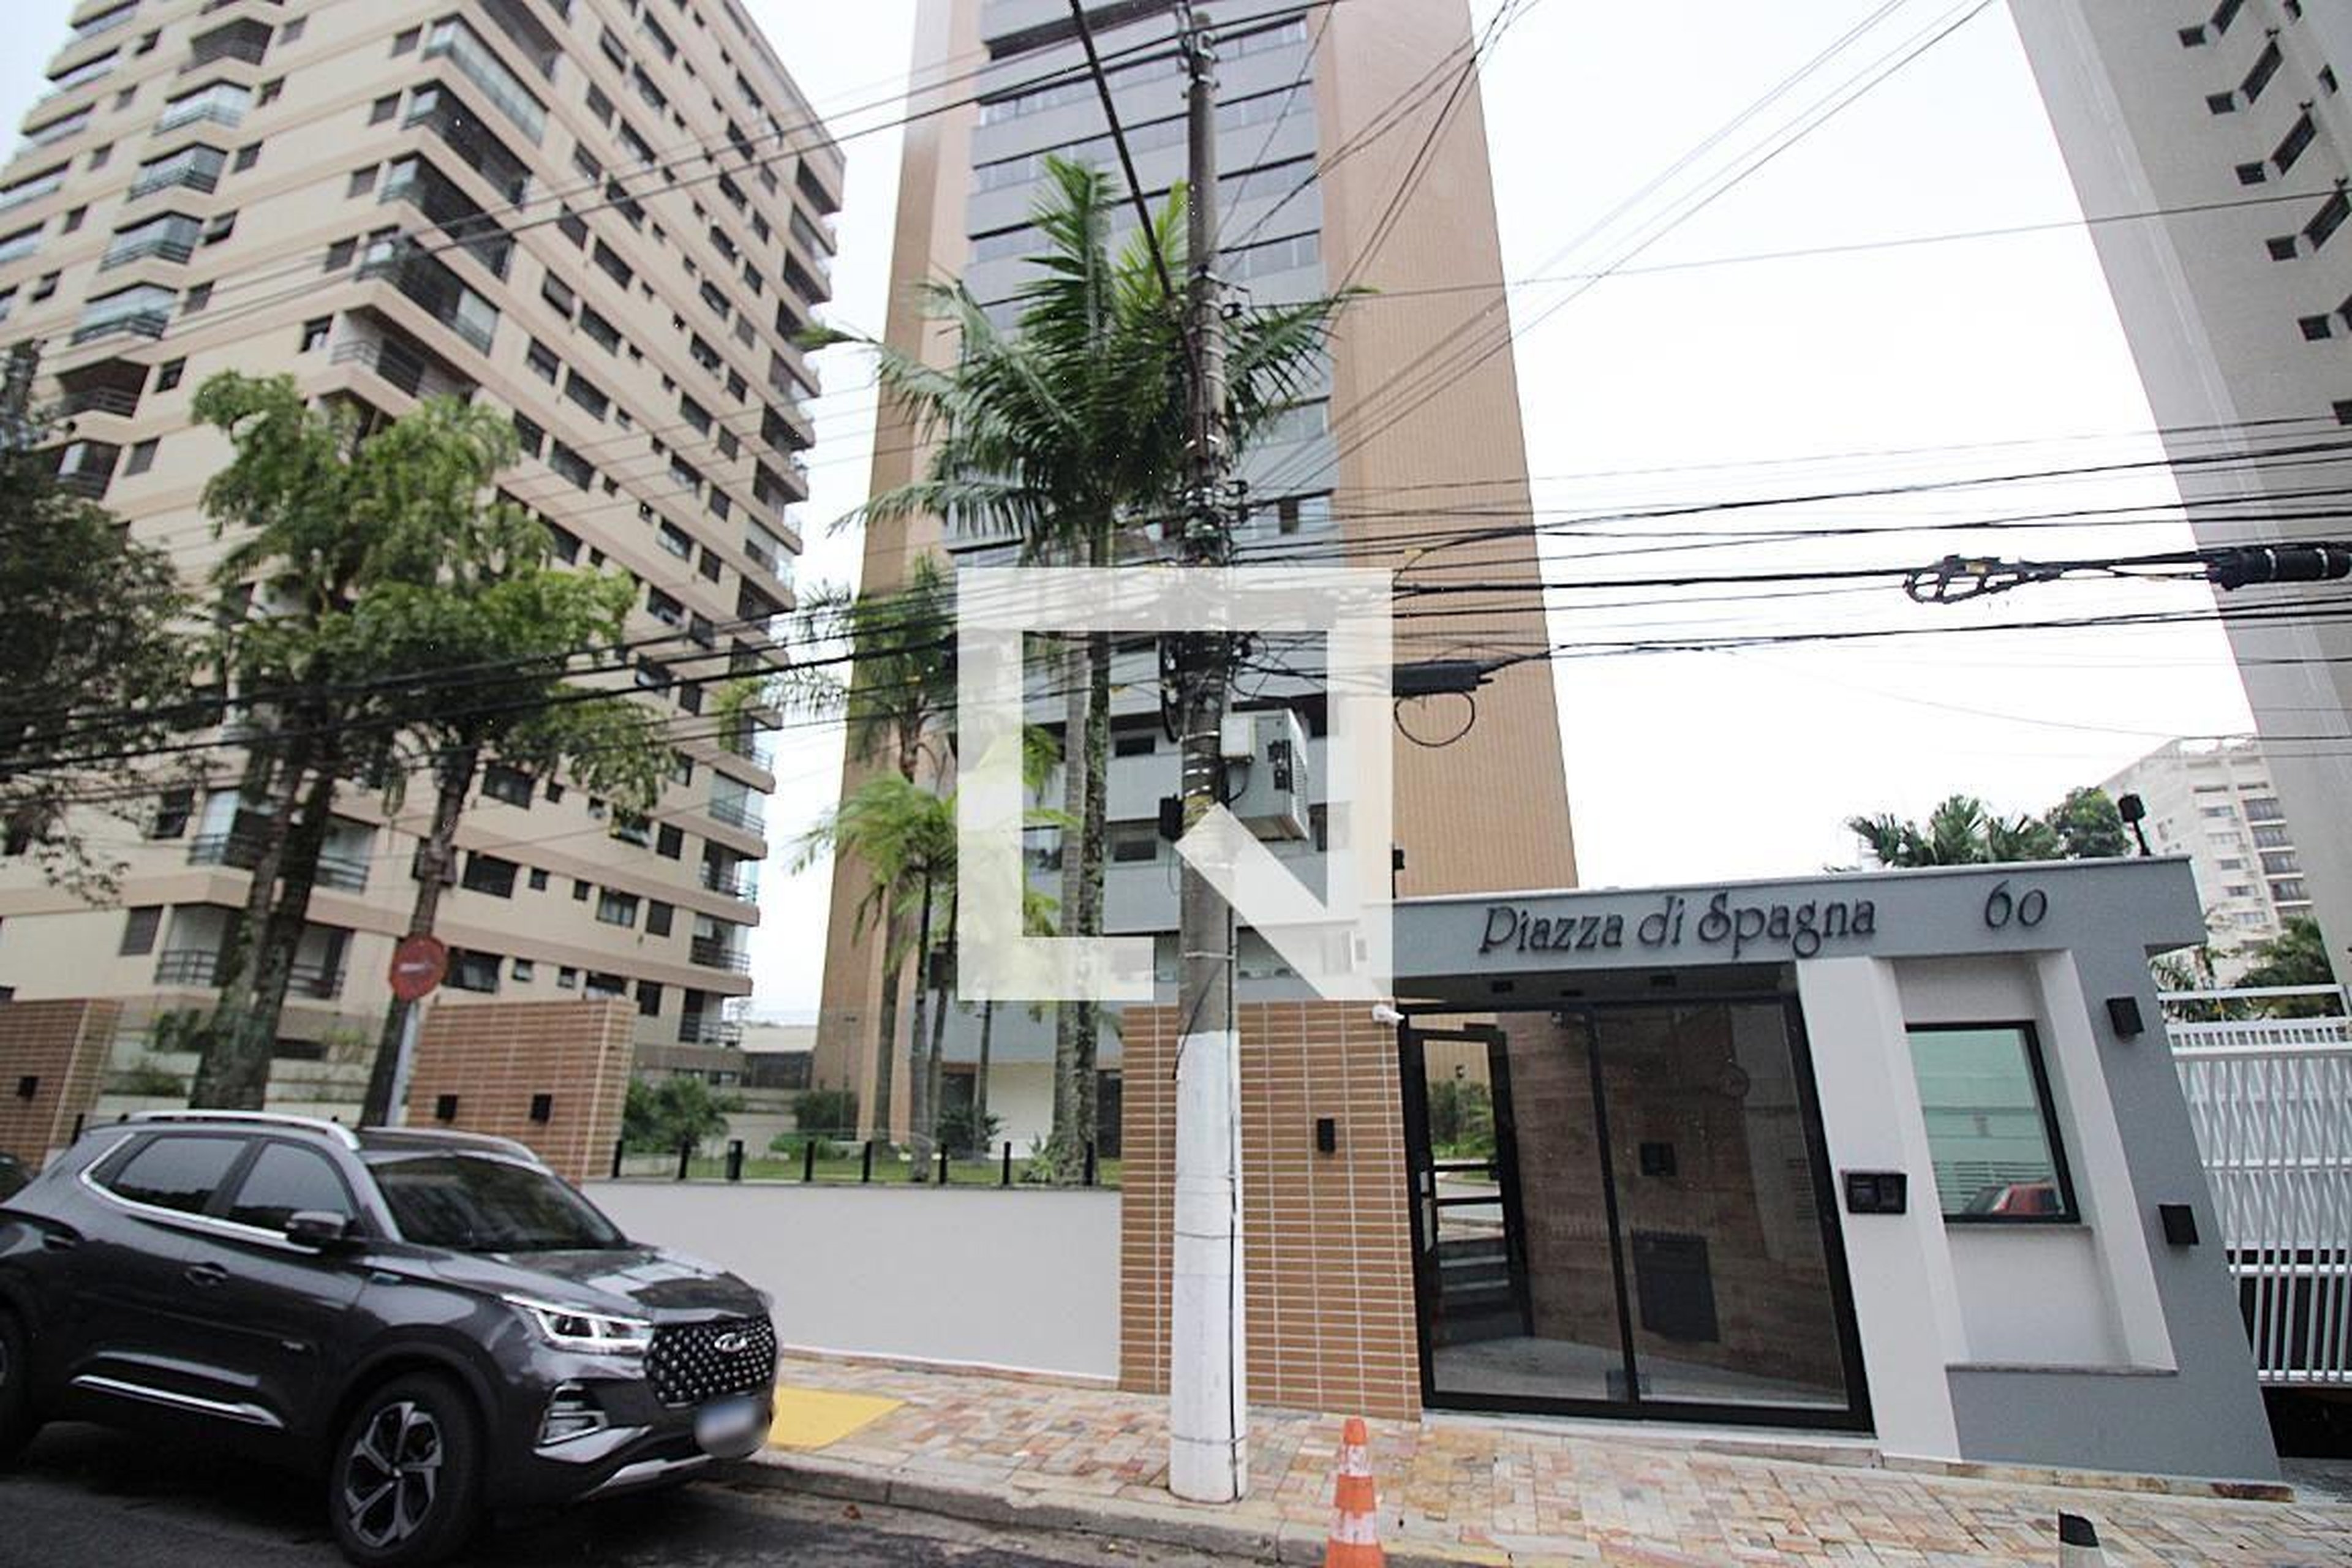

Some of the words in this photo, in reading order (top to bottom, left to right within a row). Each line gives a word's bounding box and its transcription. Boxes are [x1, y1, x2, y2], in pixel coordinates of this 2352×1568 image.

[1478, 905, 1624, 954] Piazza
[1637, 895, 1685, 946] di
[1697, 890, 1877, 959] Spagna
[1984, 880, 2048, 929] 60
